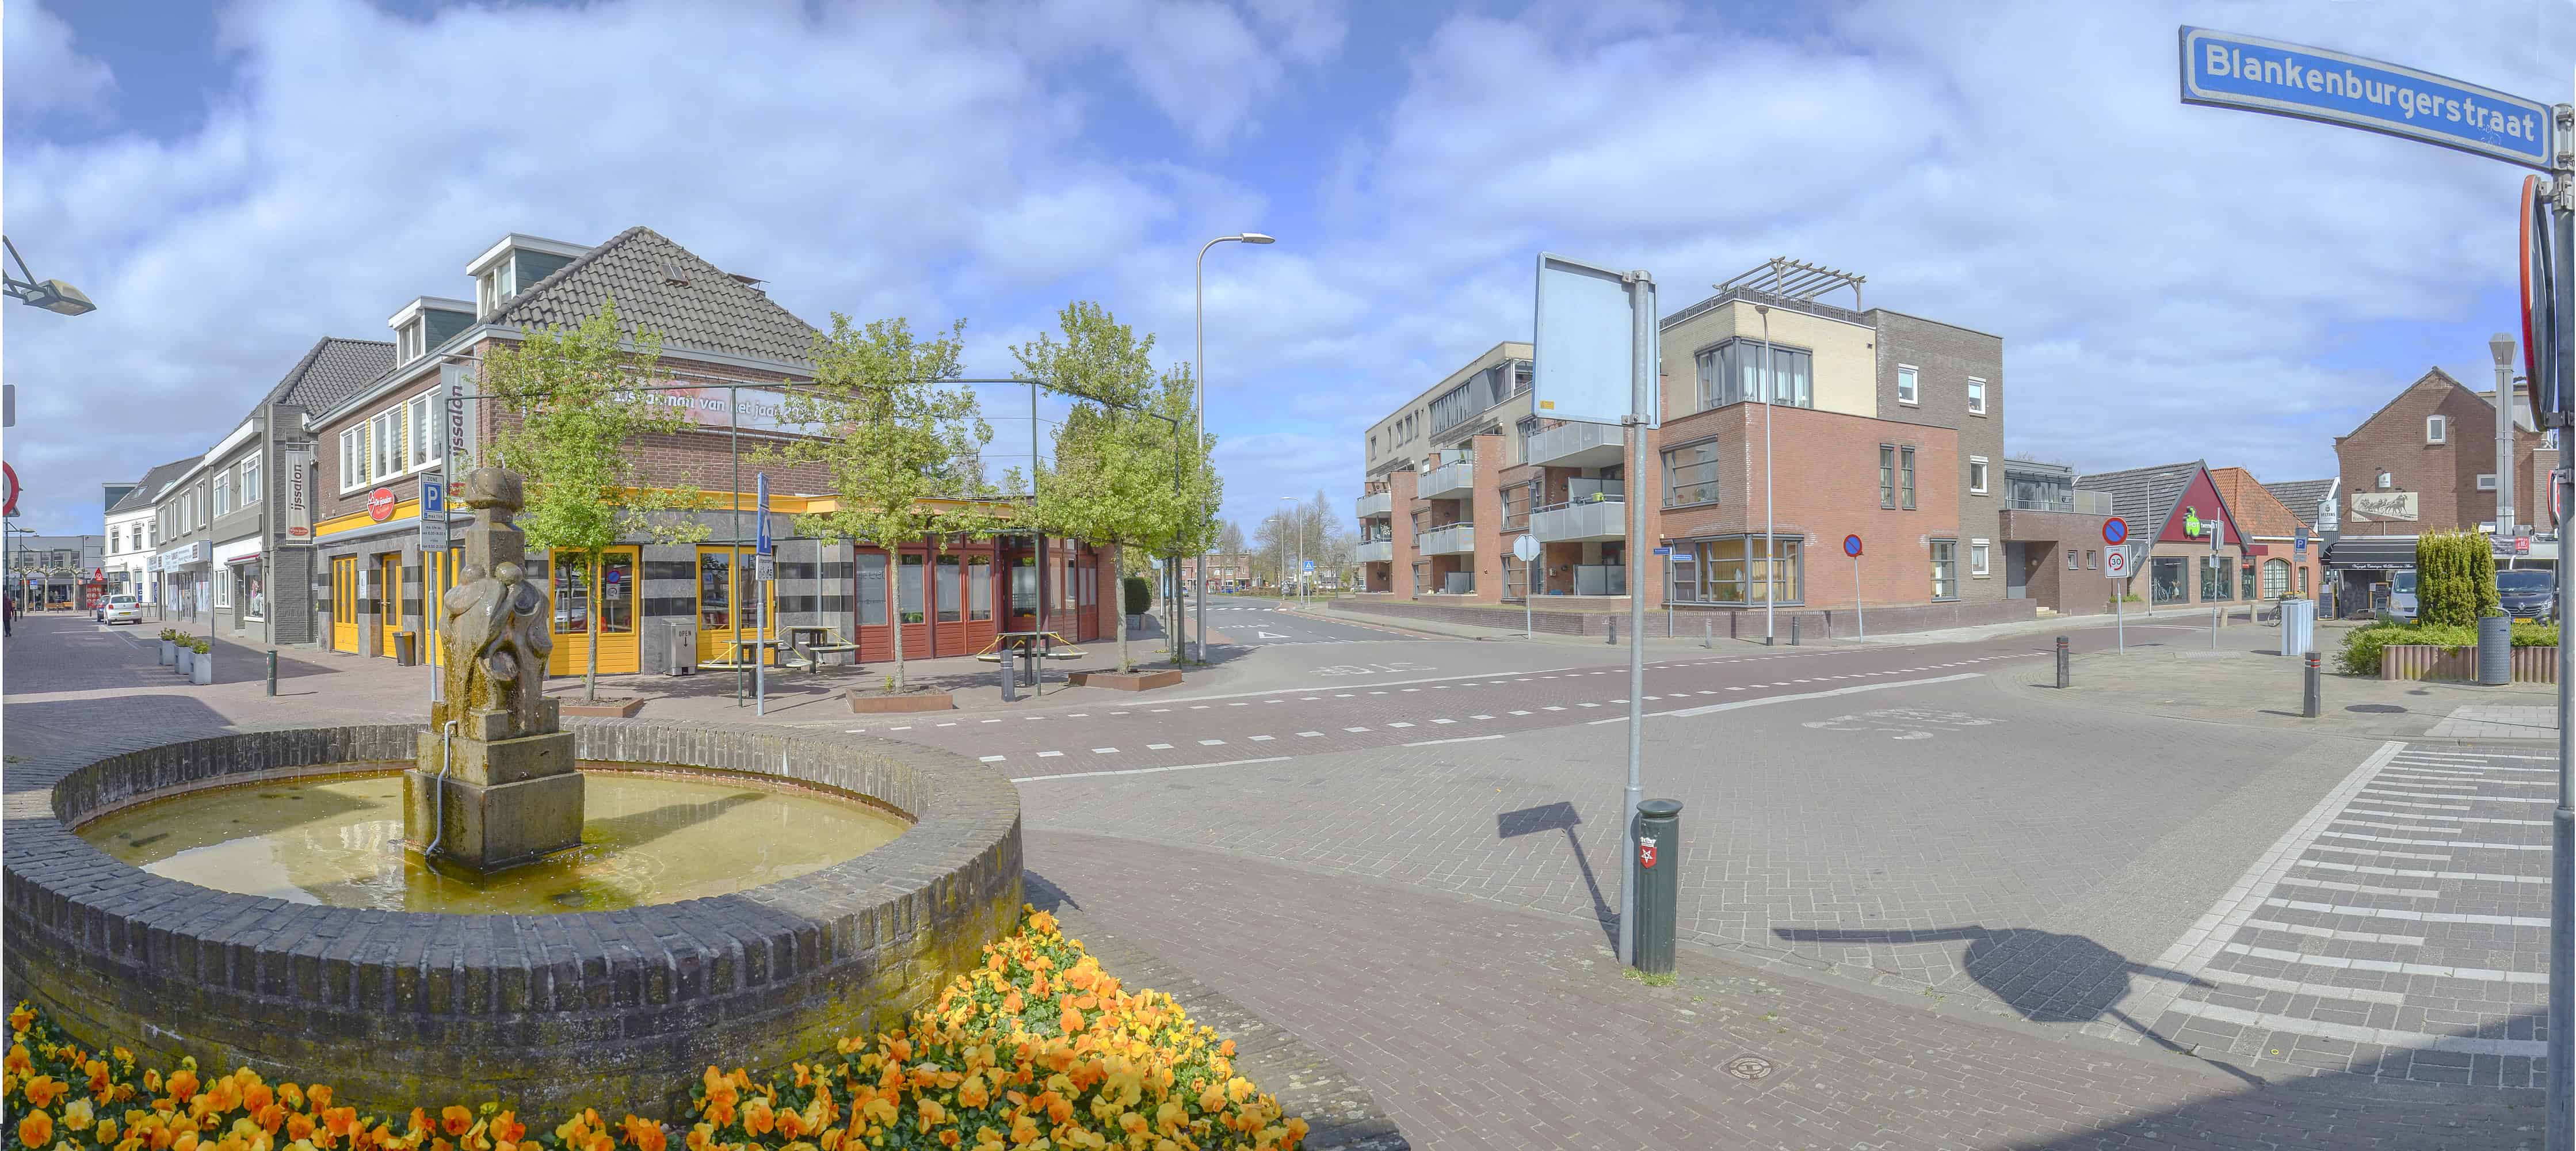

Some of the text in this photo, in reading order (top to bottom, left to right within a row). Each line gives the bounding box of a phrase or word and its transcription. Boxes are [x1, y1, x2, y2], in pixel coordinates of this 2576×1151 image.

[2206, 44, 2535, 142] Blankenburgerstraat
[700, 398, 725, 411] van
[291, 464, 306, 510] ijssalon
[428, 486, 437, 508] P
